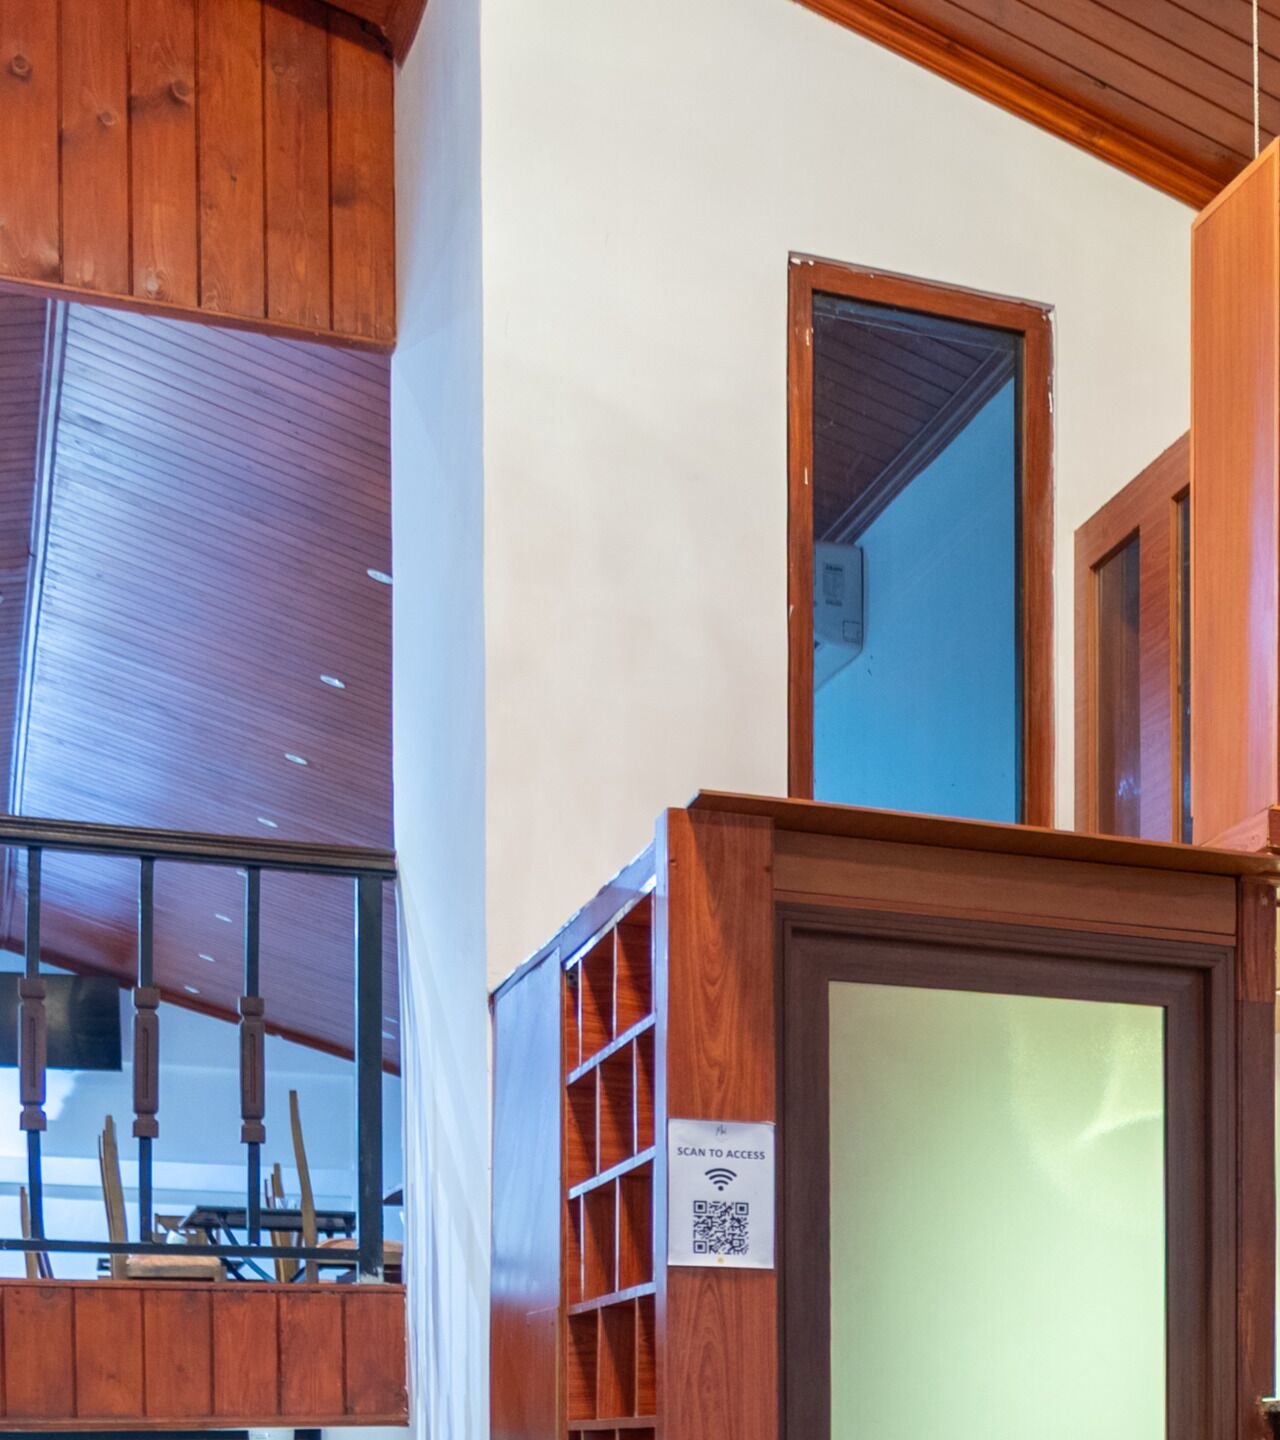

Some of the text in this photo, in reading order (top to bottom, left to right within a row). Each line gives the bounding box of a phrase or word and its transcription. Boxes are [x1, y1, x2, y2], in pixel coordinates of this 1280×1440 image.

[677, 1147, 766, 1160] SCAN TO ACCESS
